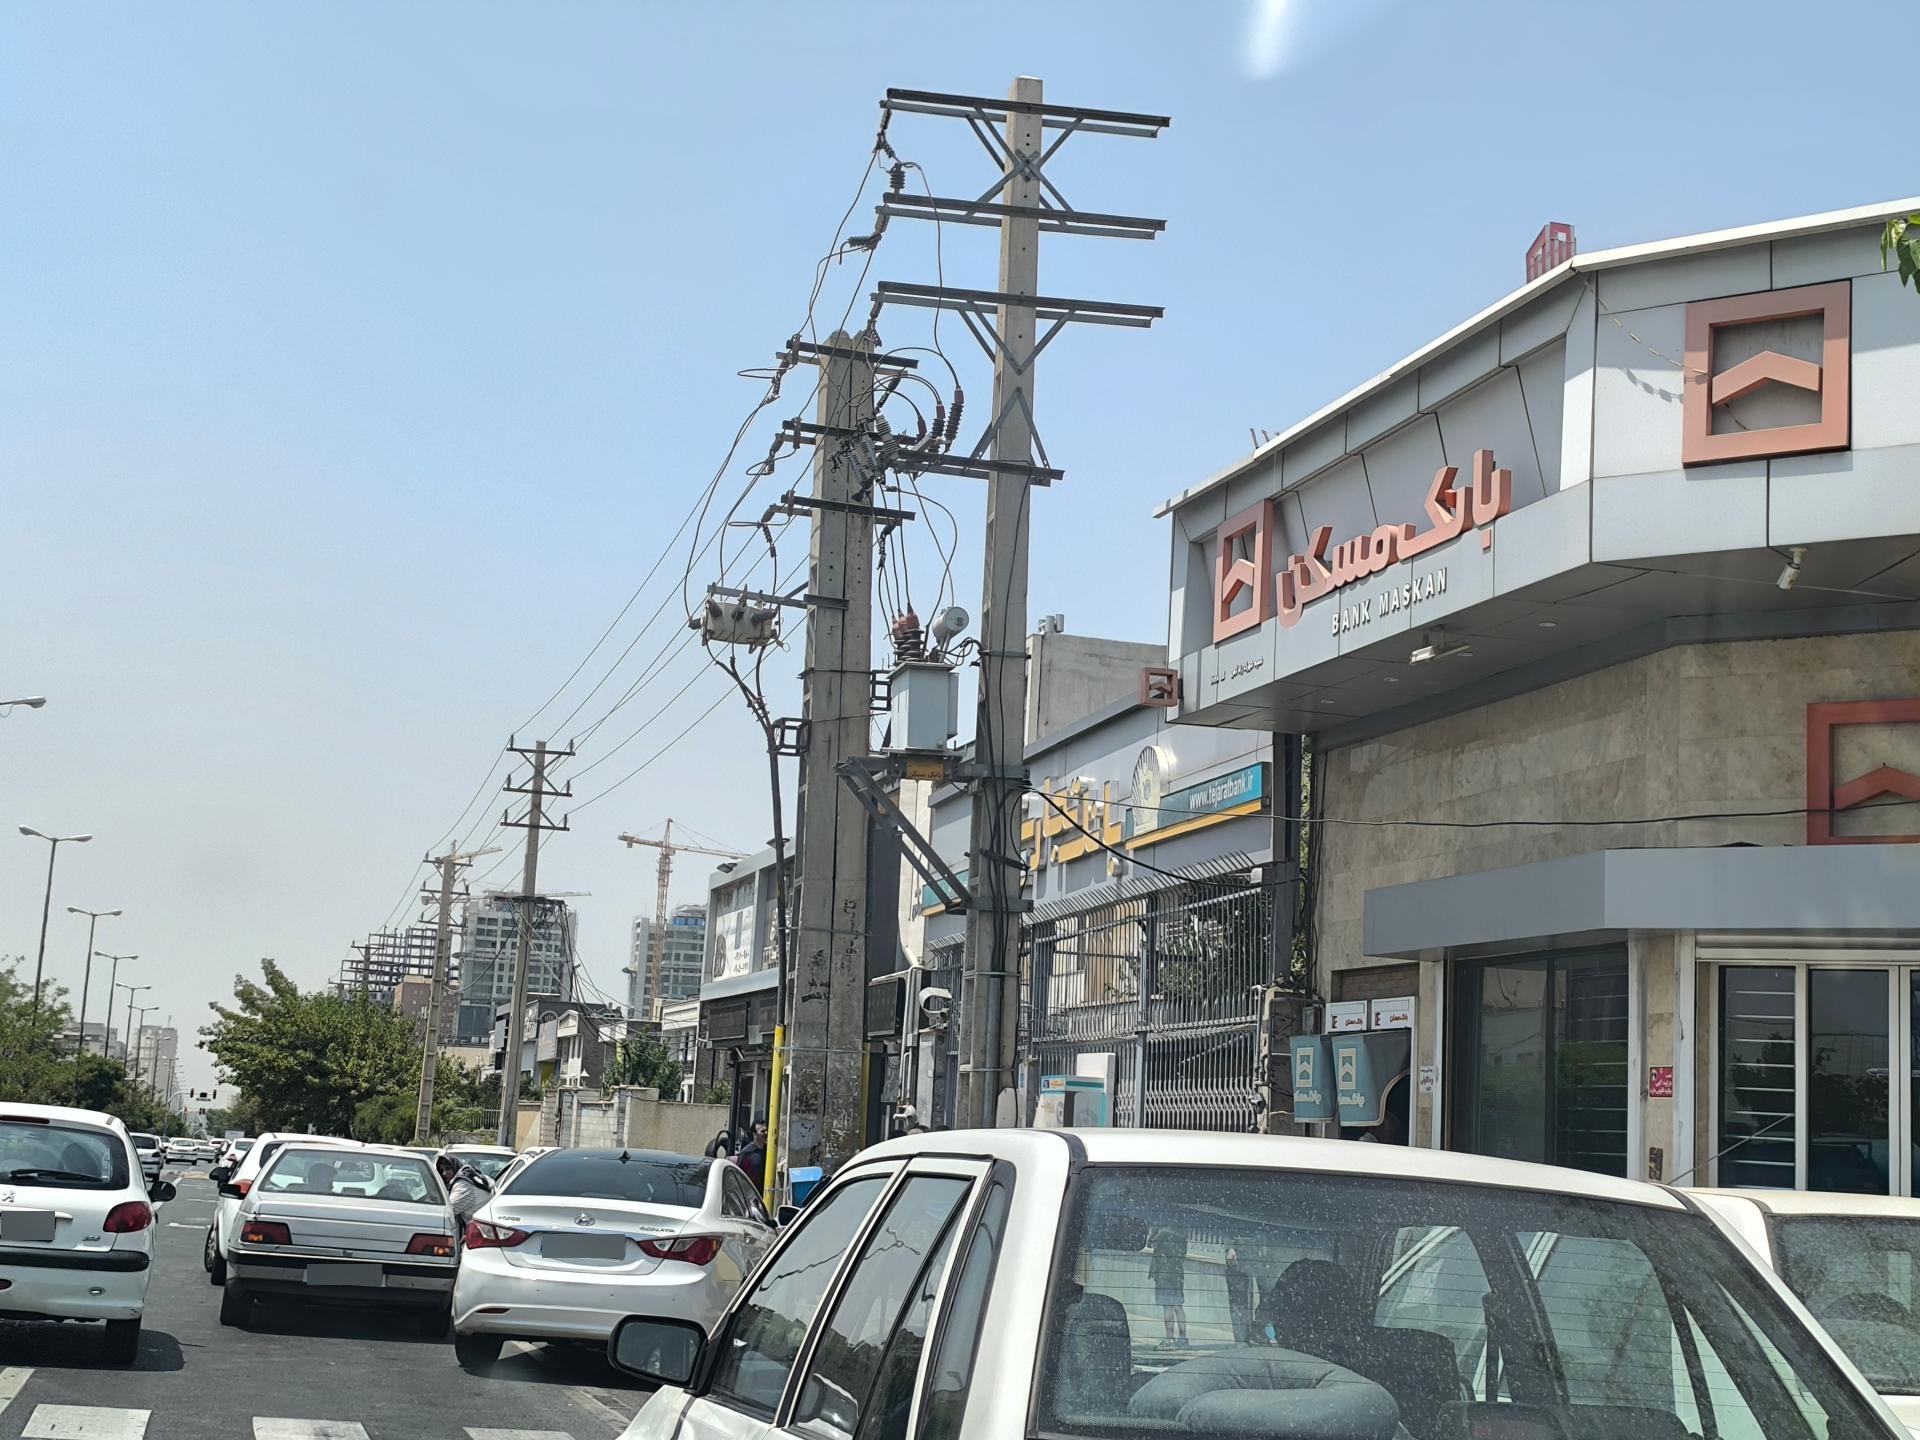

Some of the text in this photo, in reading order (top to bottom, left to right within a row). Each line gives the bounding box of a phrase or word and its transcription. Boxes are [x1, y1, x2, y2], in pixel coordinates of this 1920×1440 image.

[1276, 449, 1511, 628] بانک مسکن
[1332, 567, 1448, 636] BANK MASKAN
[1189, 772, 1255, 810] www.tejaratbank.ir
